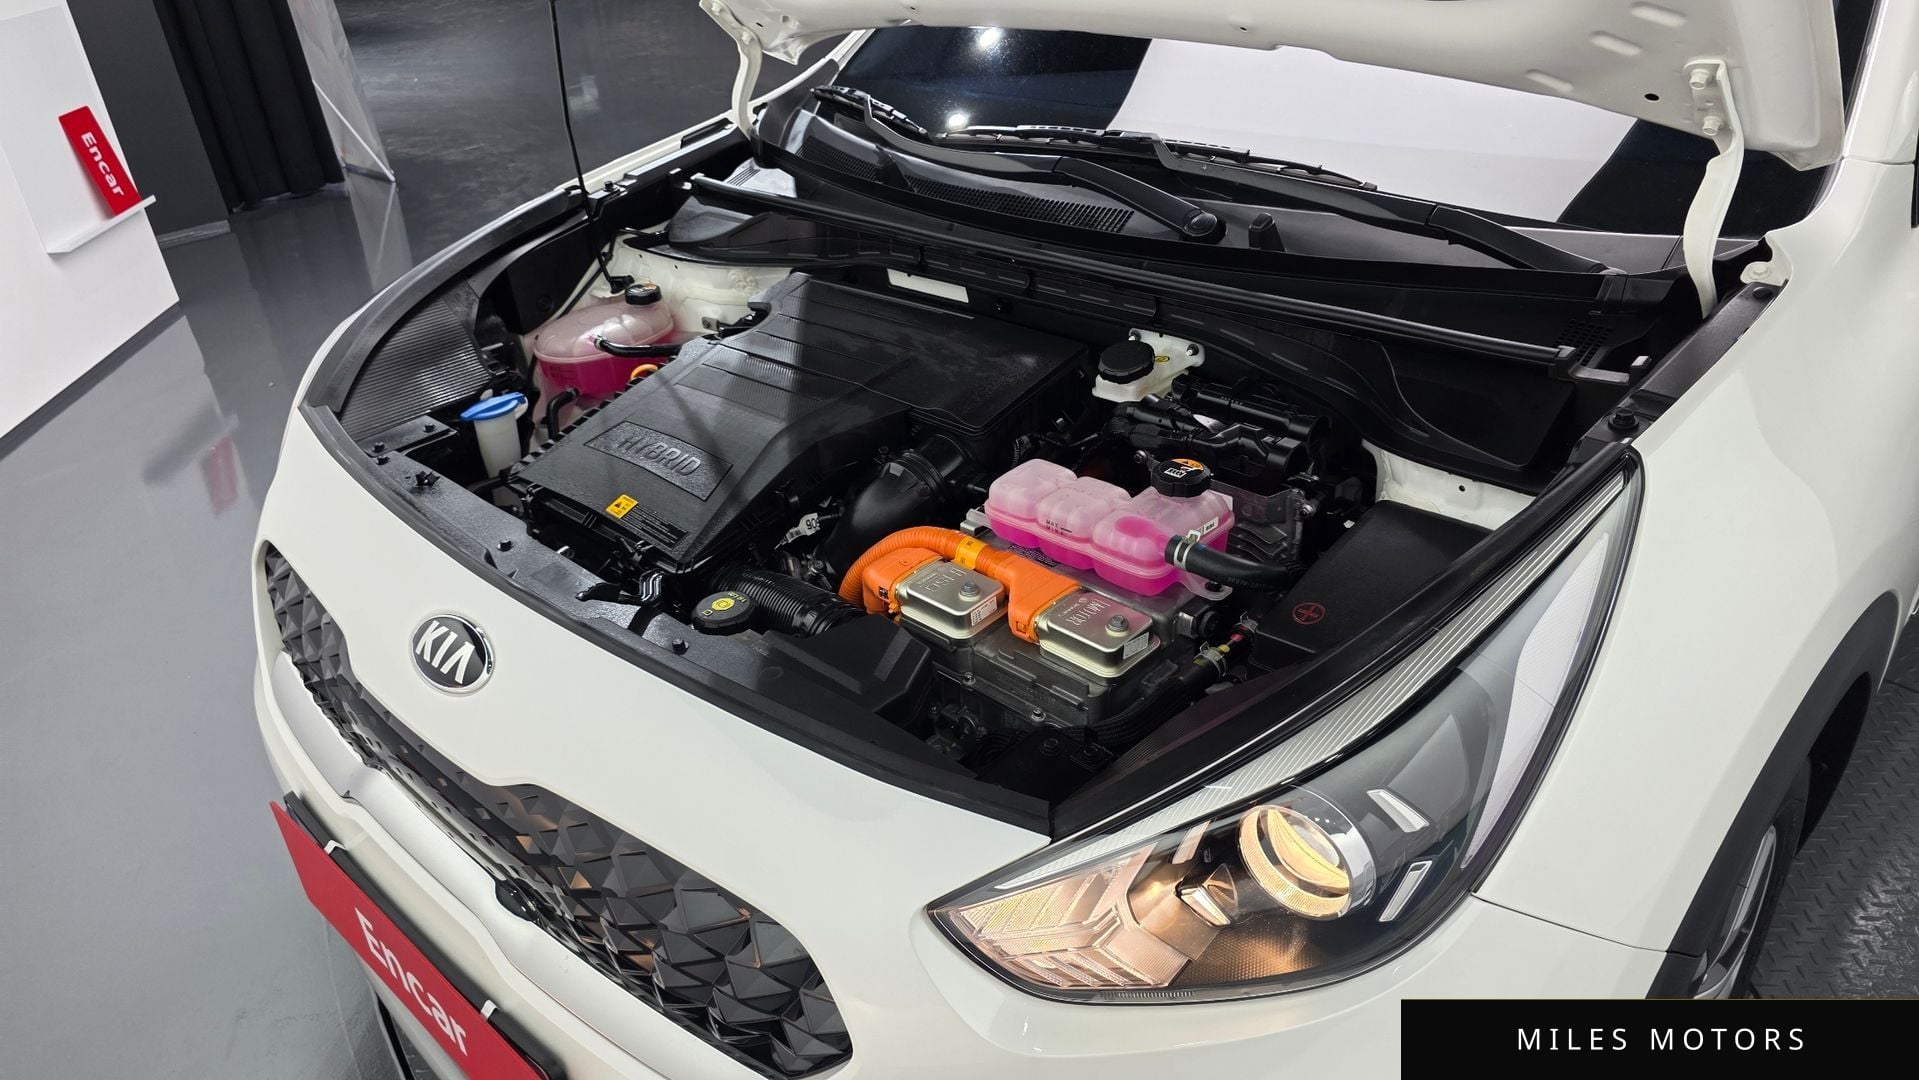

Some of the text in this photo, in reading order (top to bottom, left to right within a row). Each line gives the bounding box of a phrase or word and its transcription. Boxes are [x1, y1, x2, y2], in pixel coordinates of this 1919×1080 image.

[81, 131, 125, 197] Encar
[619, 435, 702, 477] HYBRID
[415, 620, 475, 684] KIA
[354, 907, 469, 1056] Encar
